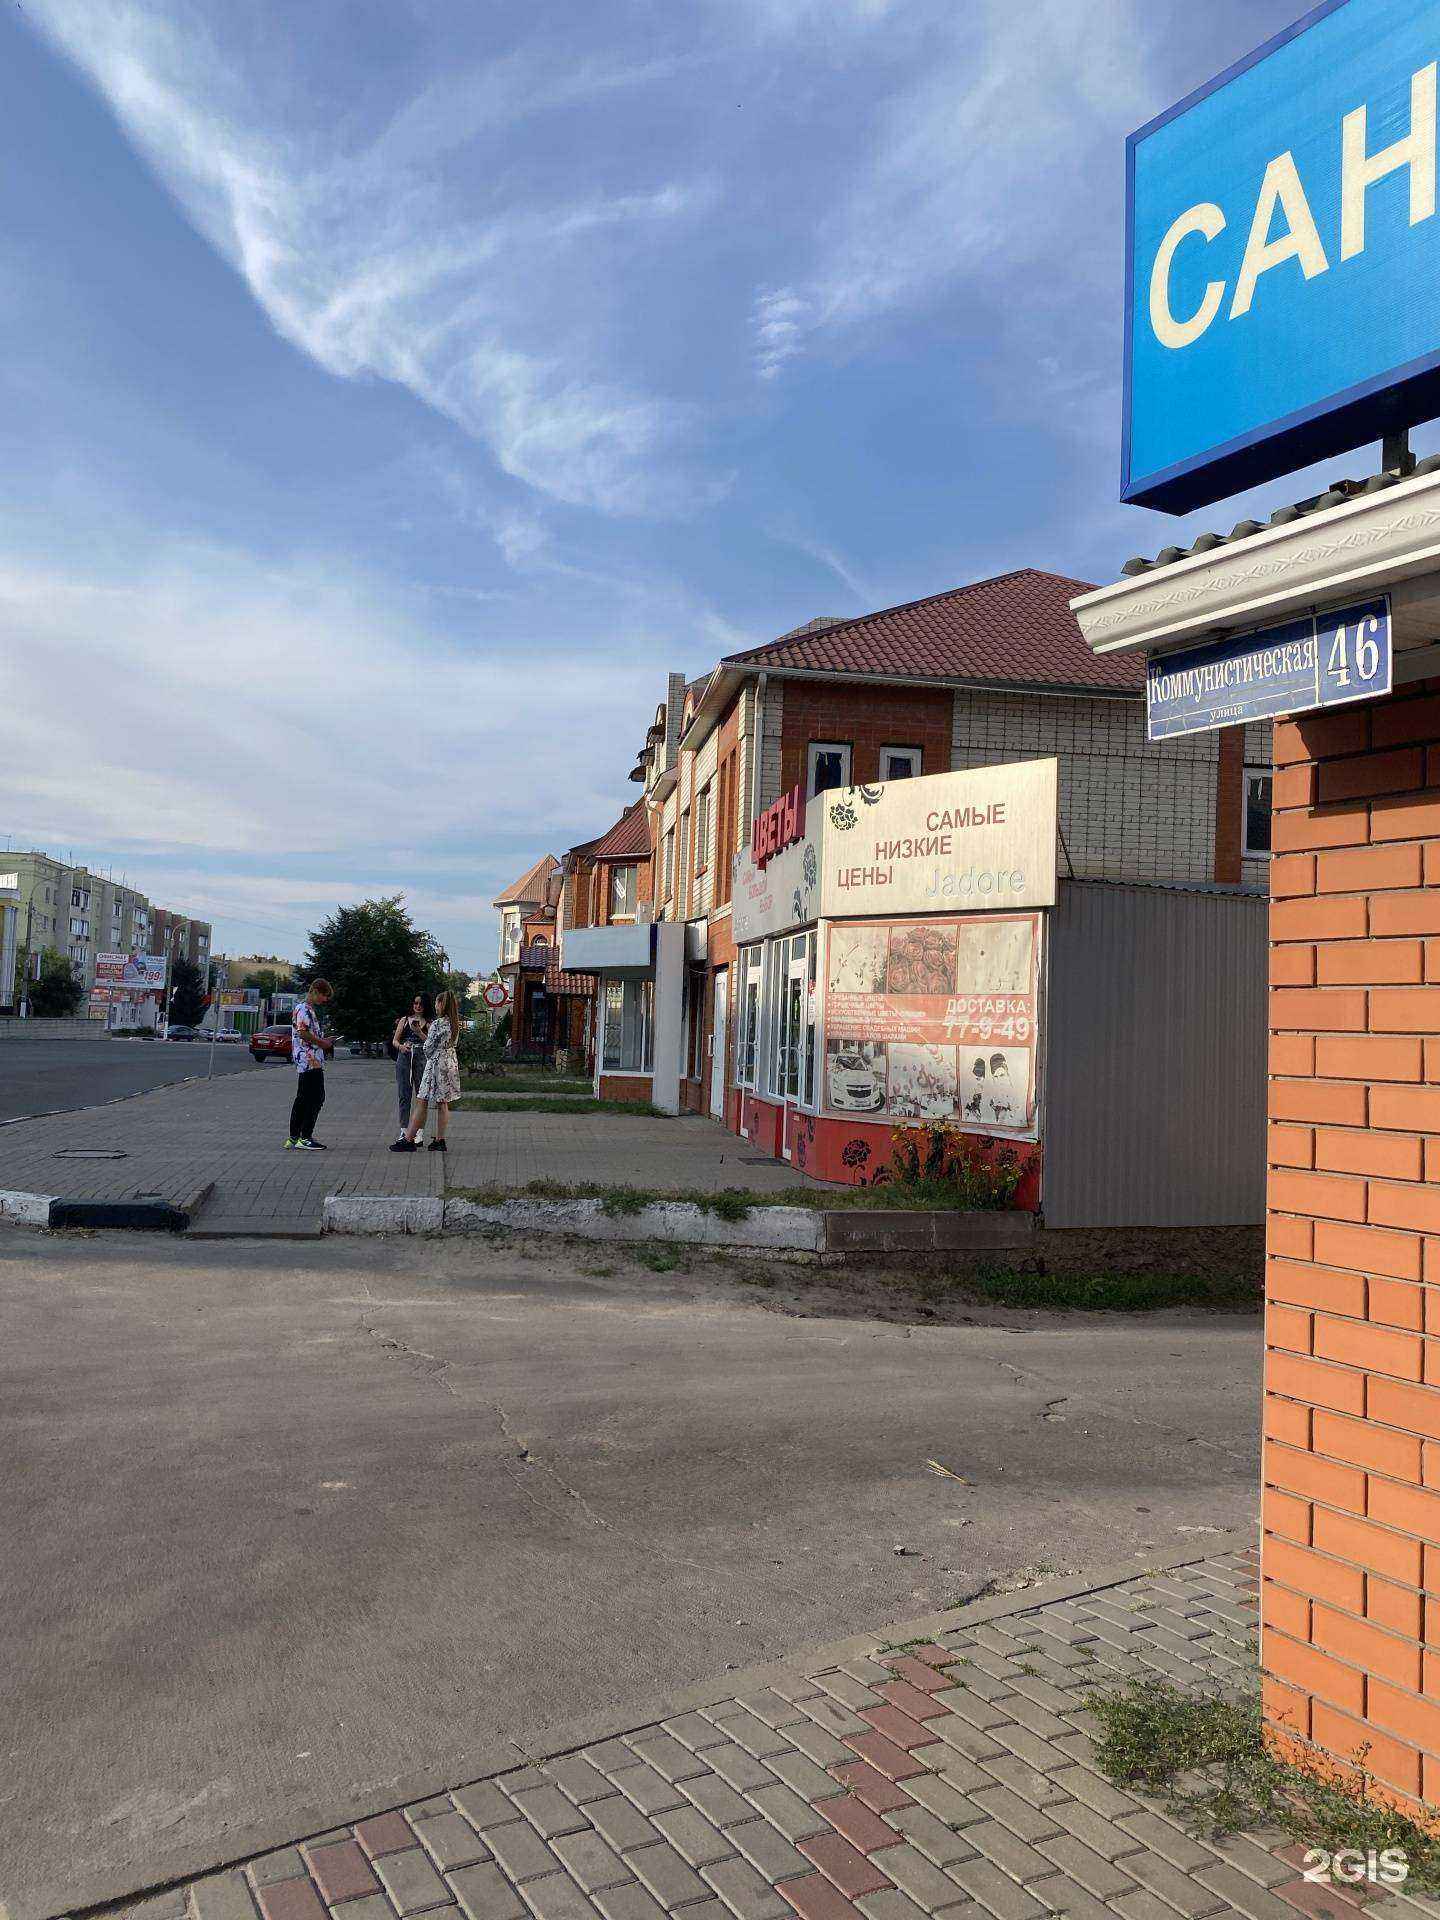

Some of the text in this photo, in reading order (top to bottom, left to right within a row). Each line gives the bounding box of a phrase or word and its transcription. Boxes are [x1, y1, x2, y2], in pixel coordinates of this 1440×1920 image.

[1149, 61, 1437, 349] САН
[1327, 613, 1380, 687] 46
[1150, 639, 1314, 704] Коммунистическая
[1209, 704, 1244, 722] улица
[752, 785, 803, 870] ЦВЕТЫ
[926, 803, 1006, 831] САМЫЕ
[875, 835, 952, 860] НИЗКИЕ
[837, 866, 893, 890] ЦЕНЫ
[926, 866, 1026, 897] Jadore
[945, 998, 1031, 1016] ДОСТАВКА:
[942, 1016, 1031, 1040] 77-9-49
